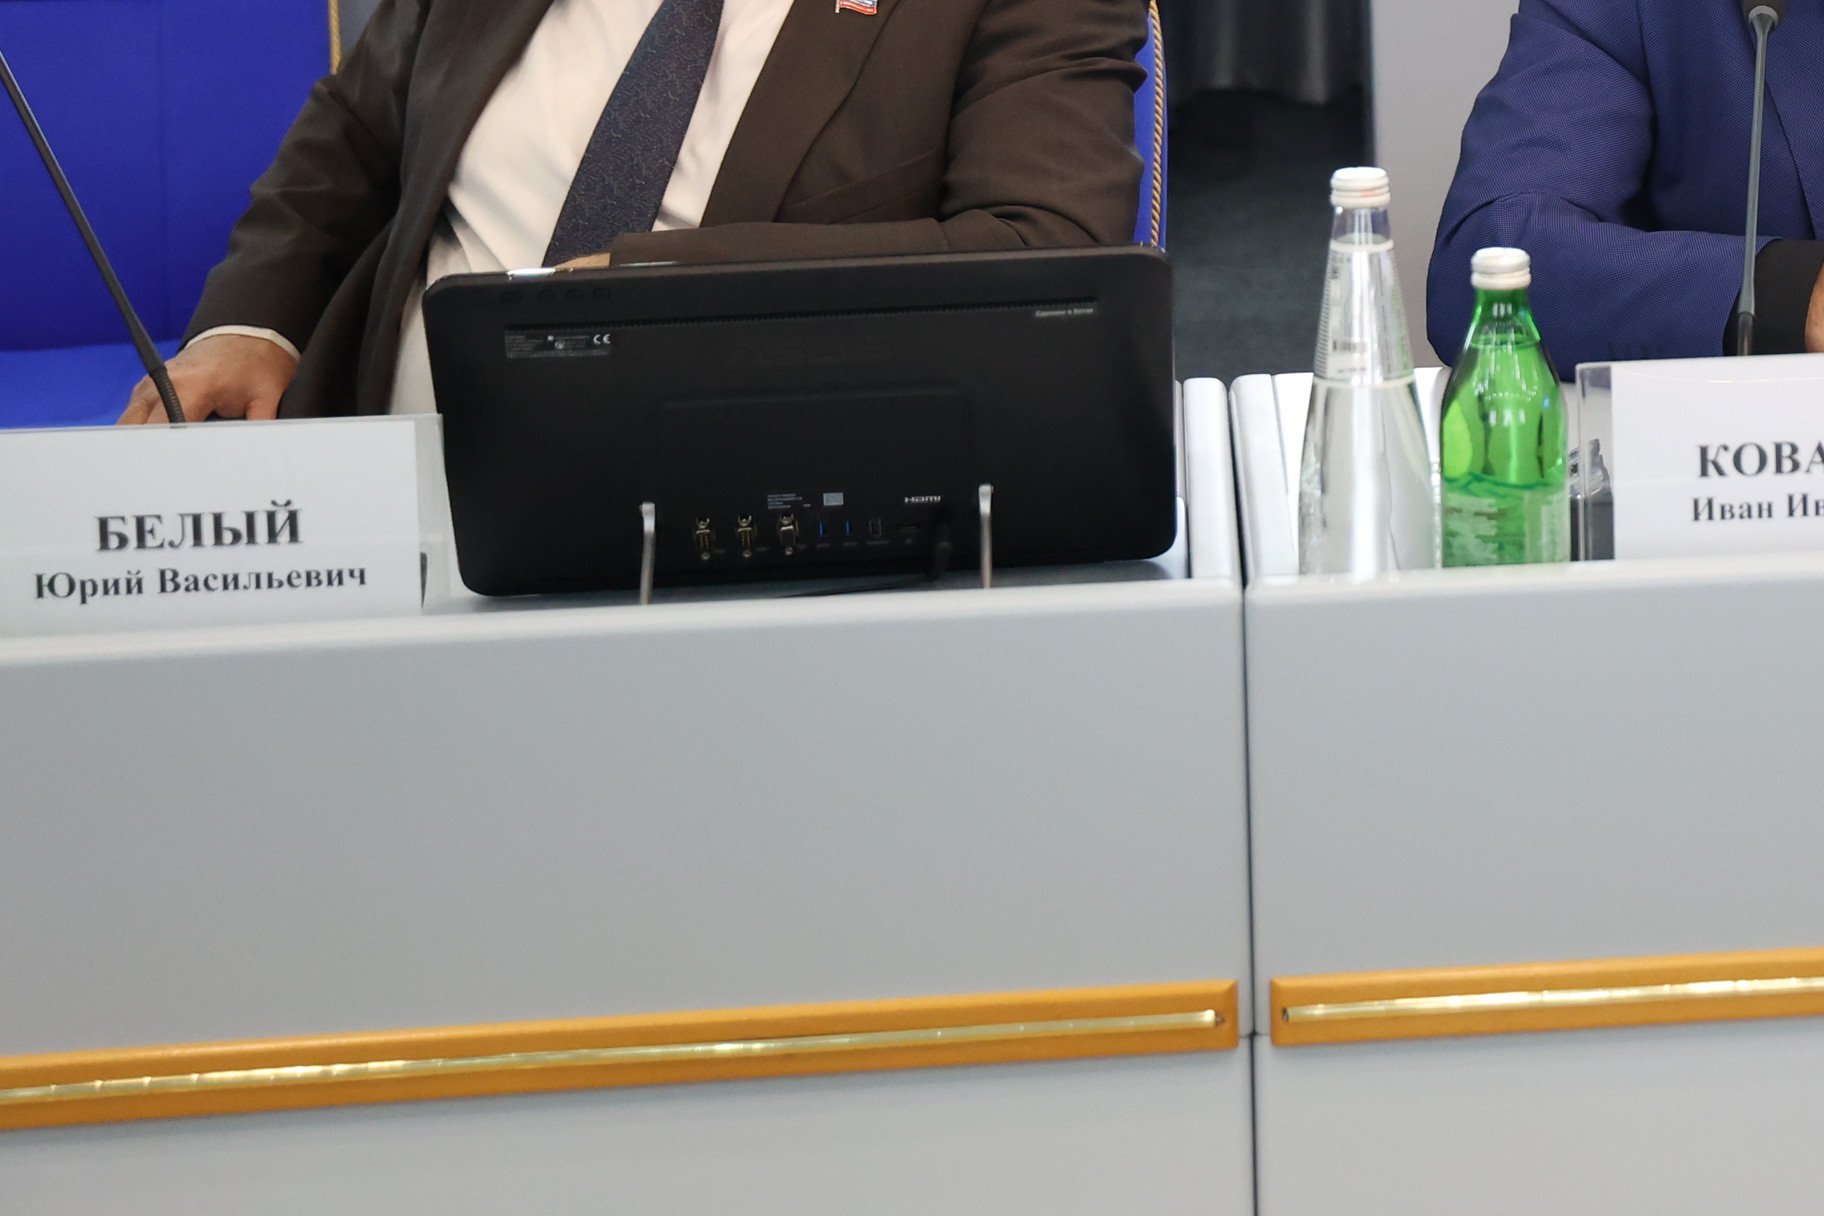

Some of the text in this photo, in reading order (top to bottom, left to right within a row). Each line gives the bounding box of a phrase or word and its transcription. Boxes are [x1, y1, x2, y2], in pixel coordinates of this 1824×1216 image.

[96, 498, 301, 552] БЕЛЫЙ
[1692, 496, 1775, 522] Иван
[34, 566, 367, 605] Юрий Васильевич
